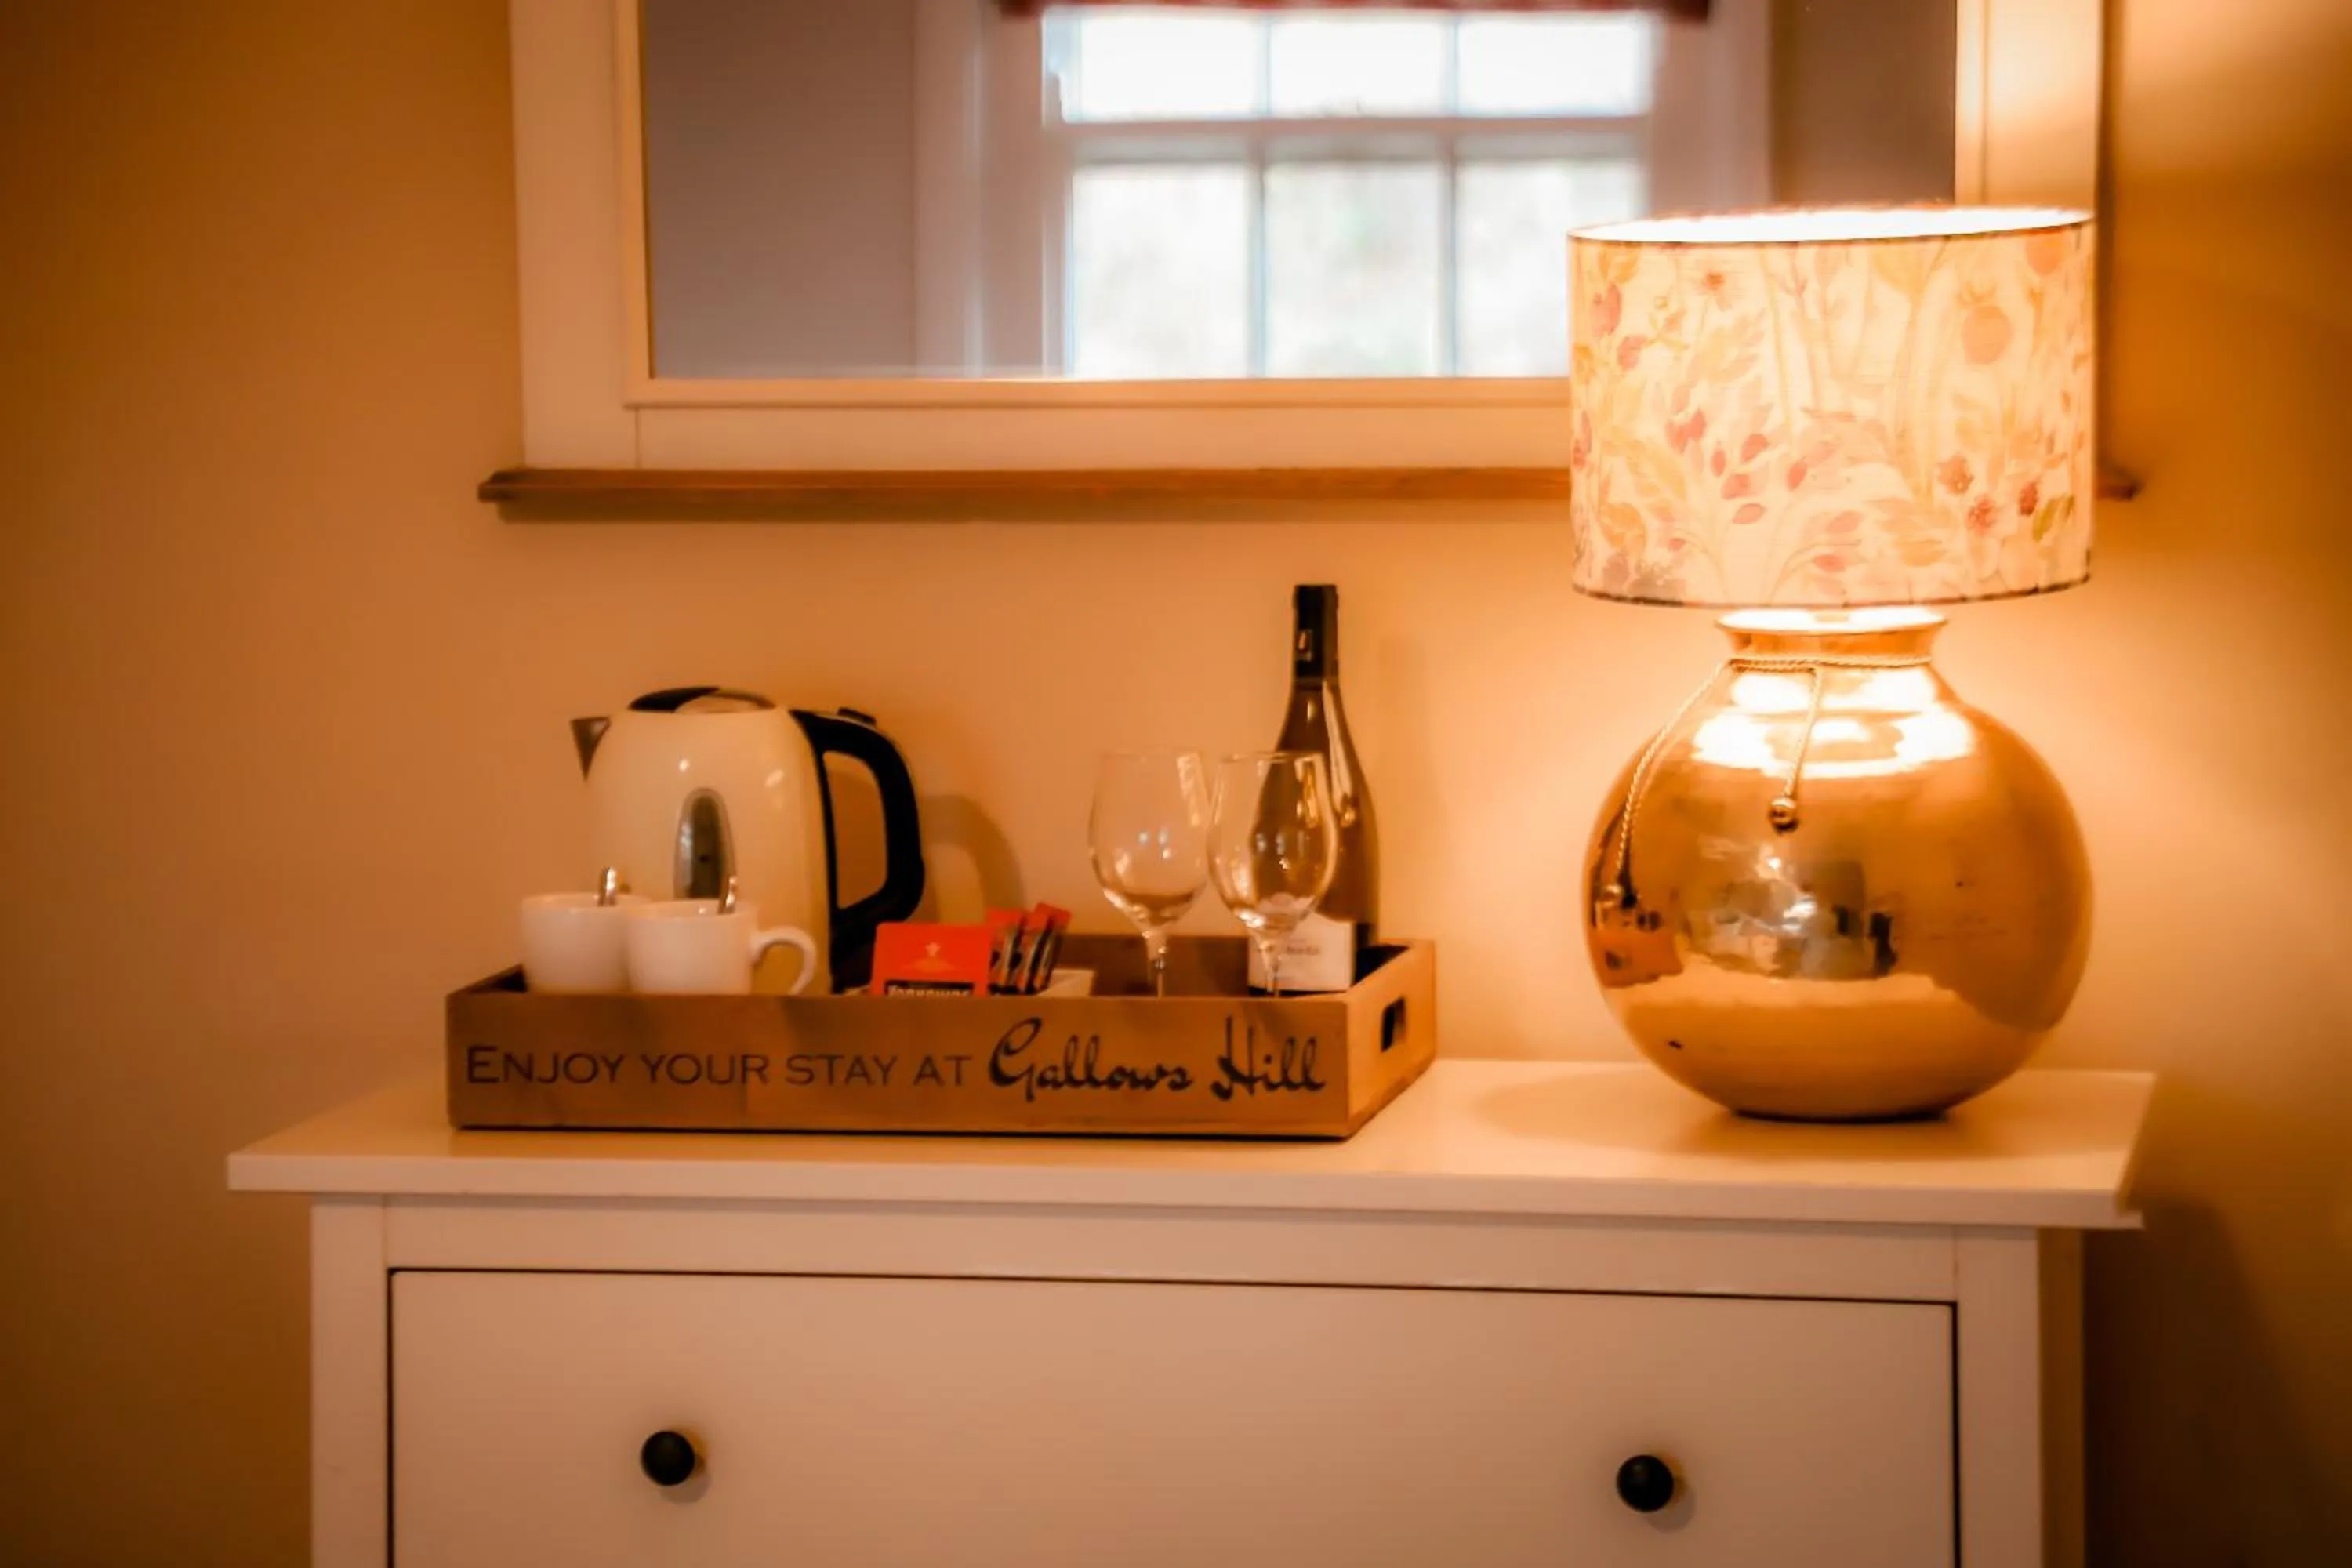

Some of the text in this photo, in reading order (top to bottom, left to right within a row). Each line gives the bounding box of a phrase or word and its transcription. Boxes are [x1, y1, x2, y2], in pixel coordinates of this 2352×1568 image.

[466, 1014, 1326, 1103] ENJOY YOUR STAY AT Gallows Hill
